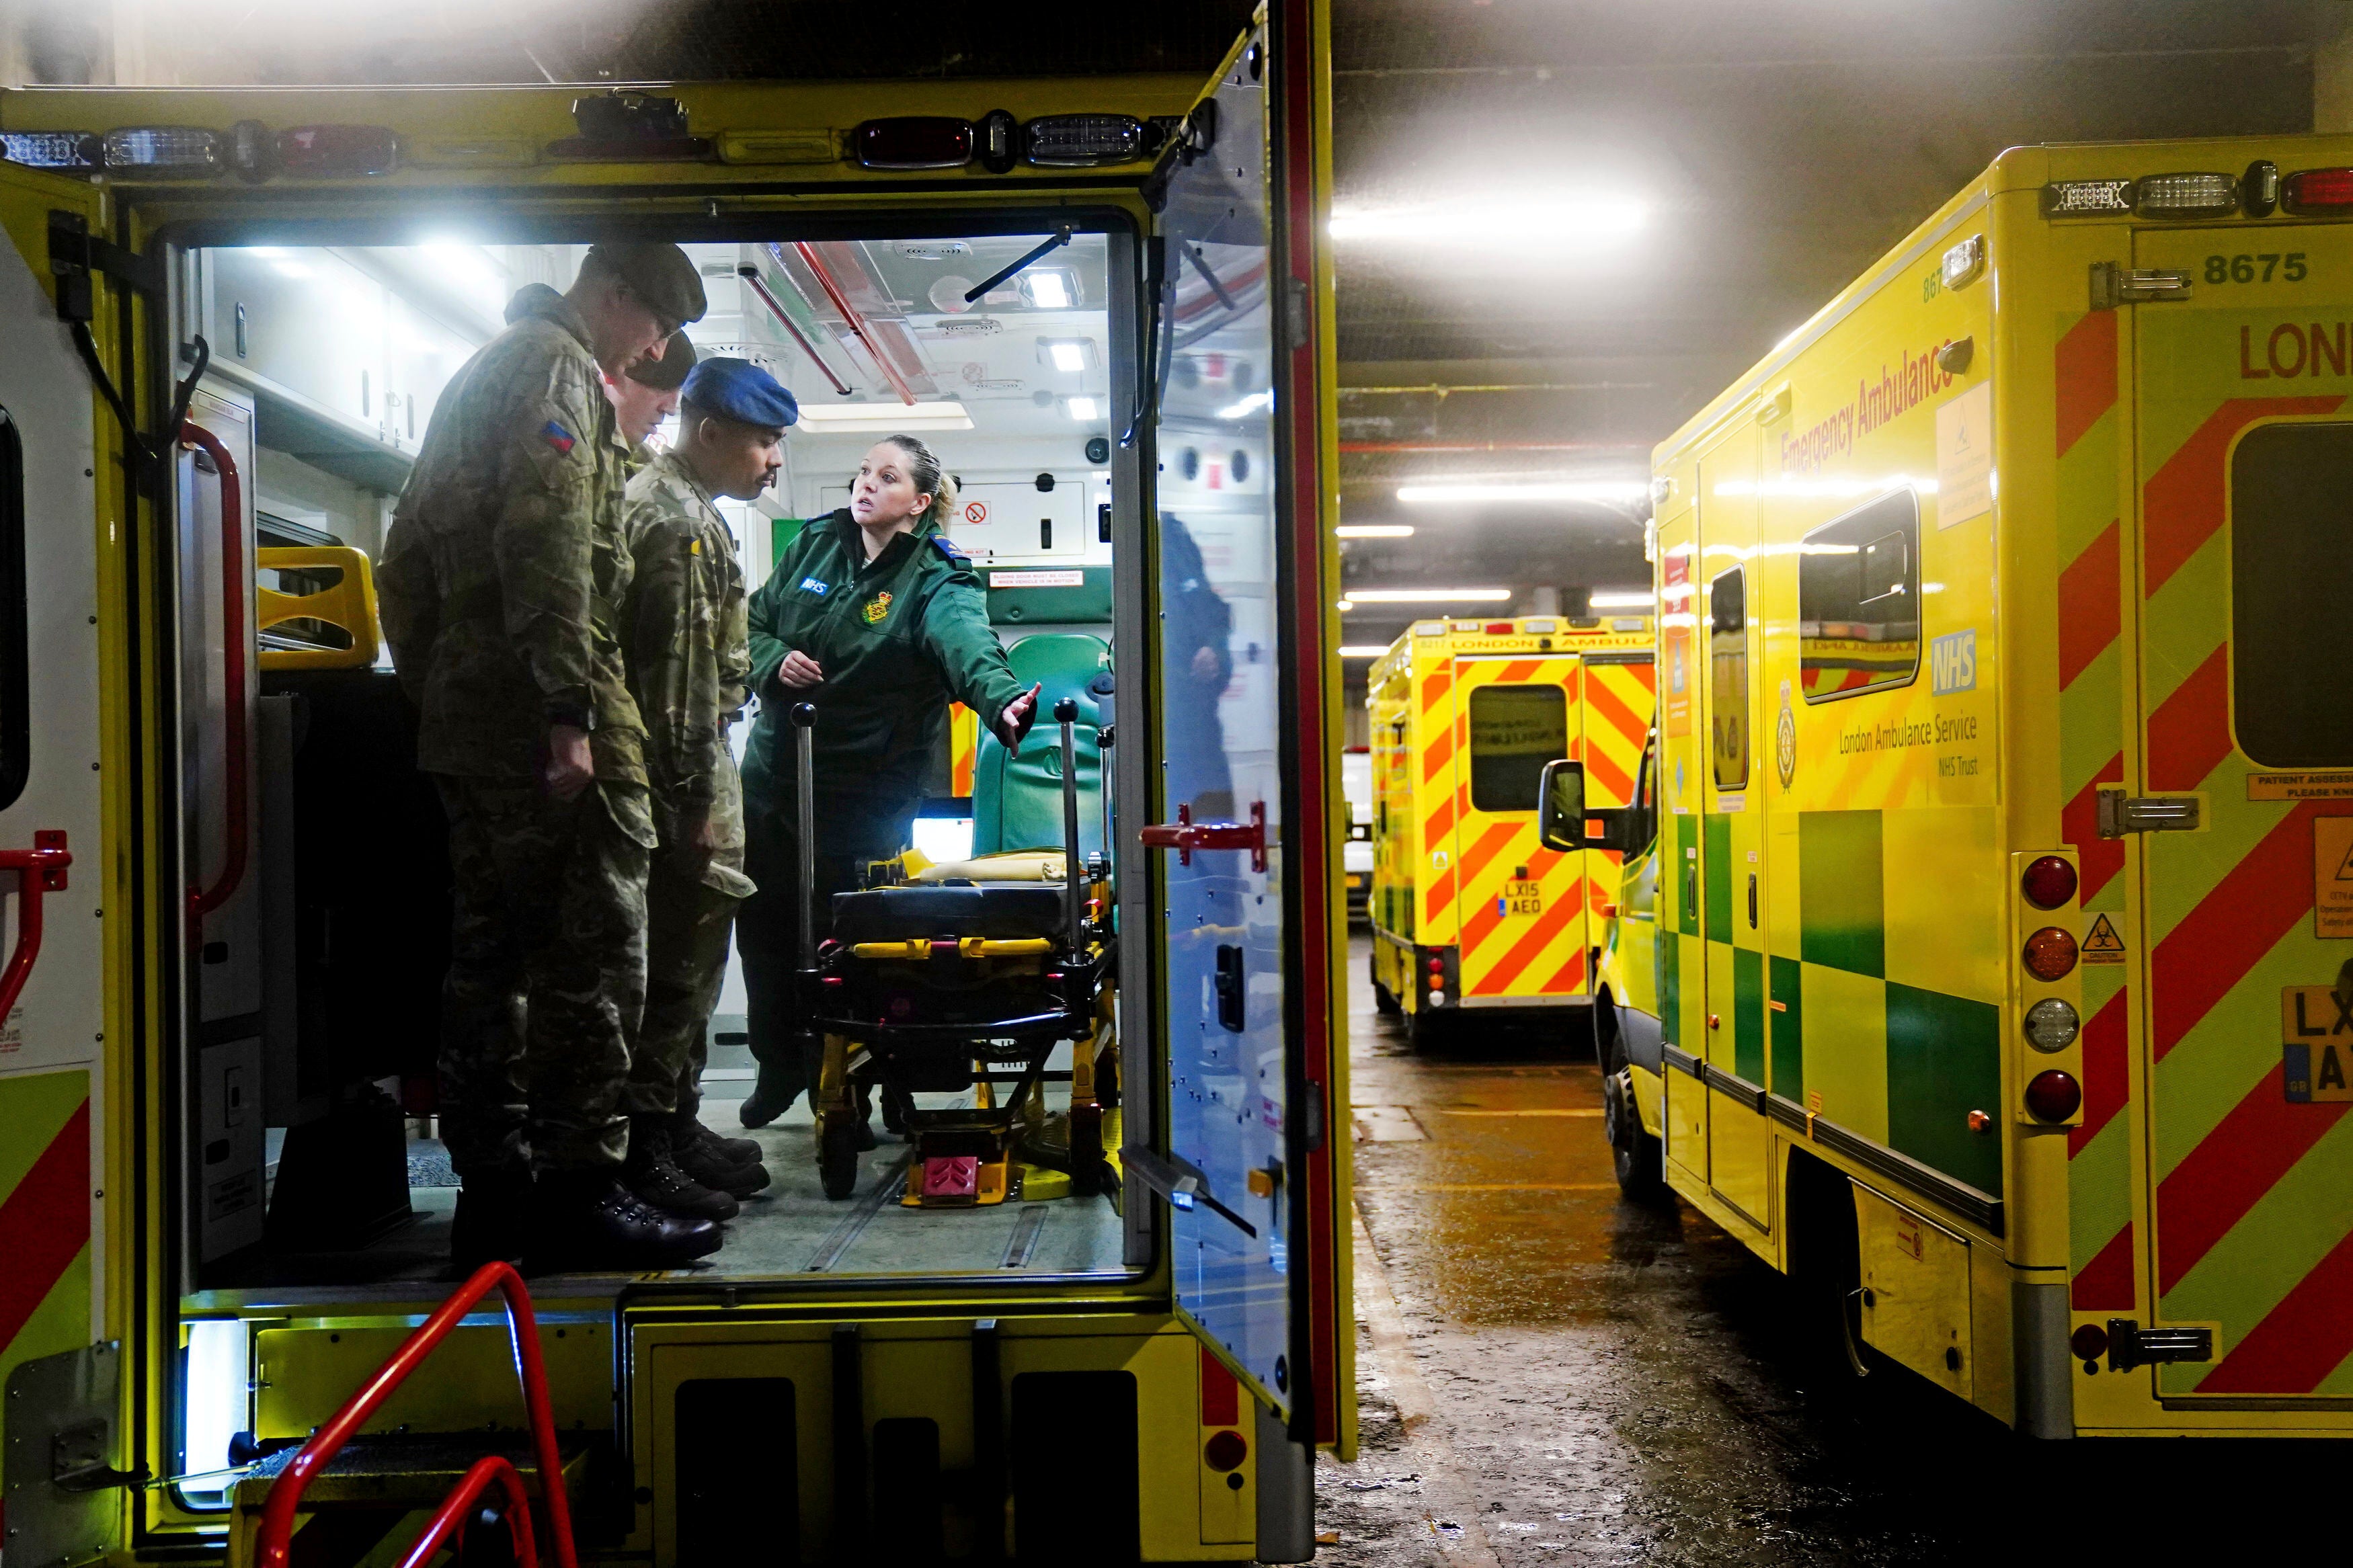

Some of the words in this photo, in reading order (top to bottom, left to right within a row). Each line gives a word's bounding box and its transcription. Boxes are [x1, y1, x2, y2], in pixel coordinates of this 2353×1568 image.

[1923, 267, 1943, 303] 867
[2204, 253, 2308, 285] 8675
[2240, 322, 2353, 379] LON
[1782, 401, 1854, 470] Emergency
[803, 579, 827, 595] NHS
[1451, 639, 1533, 649] LONDON
[1933, 634, 1975, 692] NHS
[1839, 727, 1872, 754] London
[1875, 717, 1931, 751] Ambulance
[1936, 710, 1977, 743] Service
[1938, 756, 1956, 776] NHS
[1957, 755, 1978, 775] Trust
[2258, 776, 2305, 784] PATIENT
[2307, 775, 2353, 784] ASSESS
[1505, 883, 1538, 897] LX15
[2318, 1044, 2353, 1089] A
